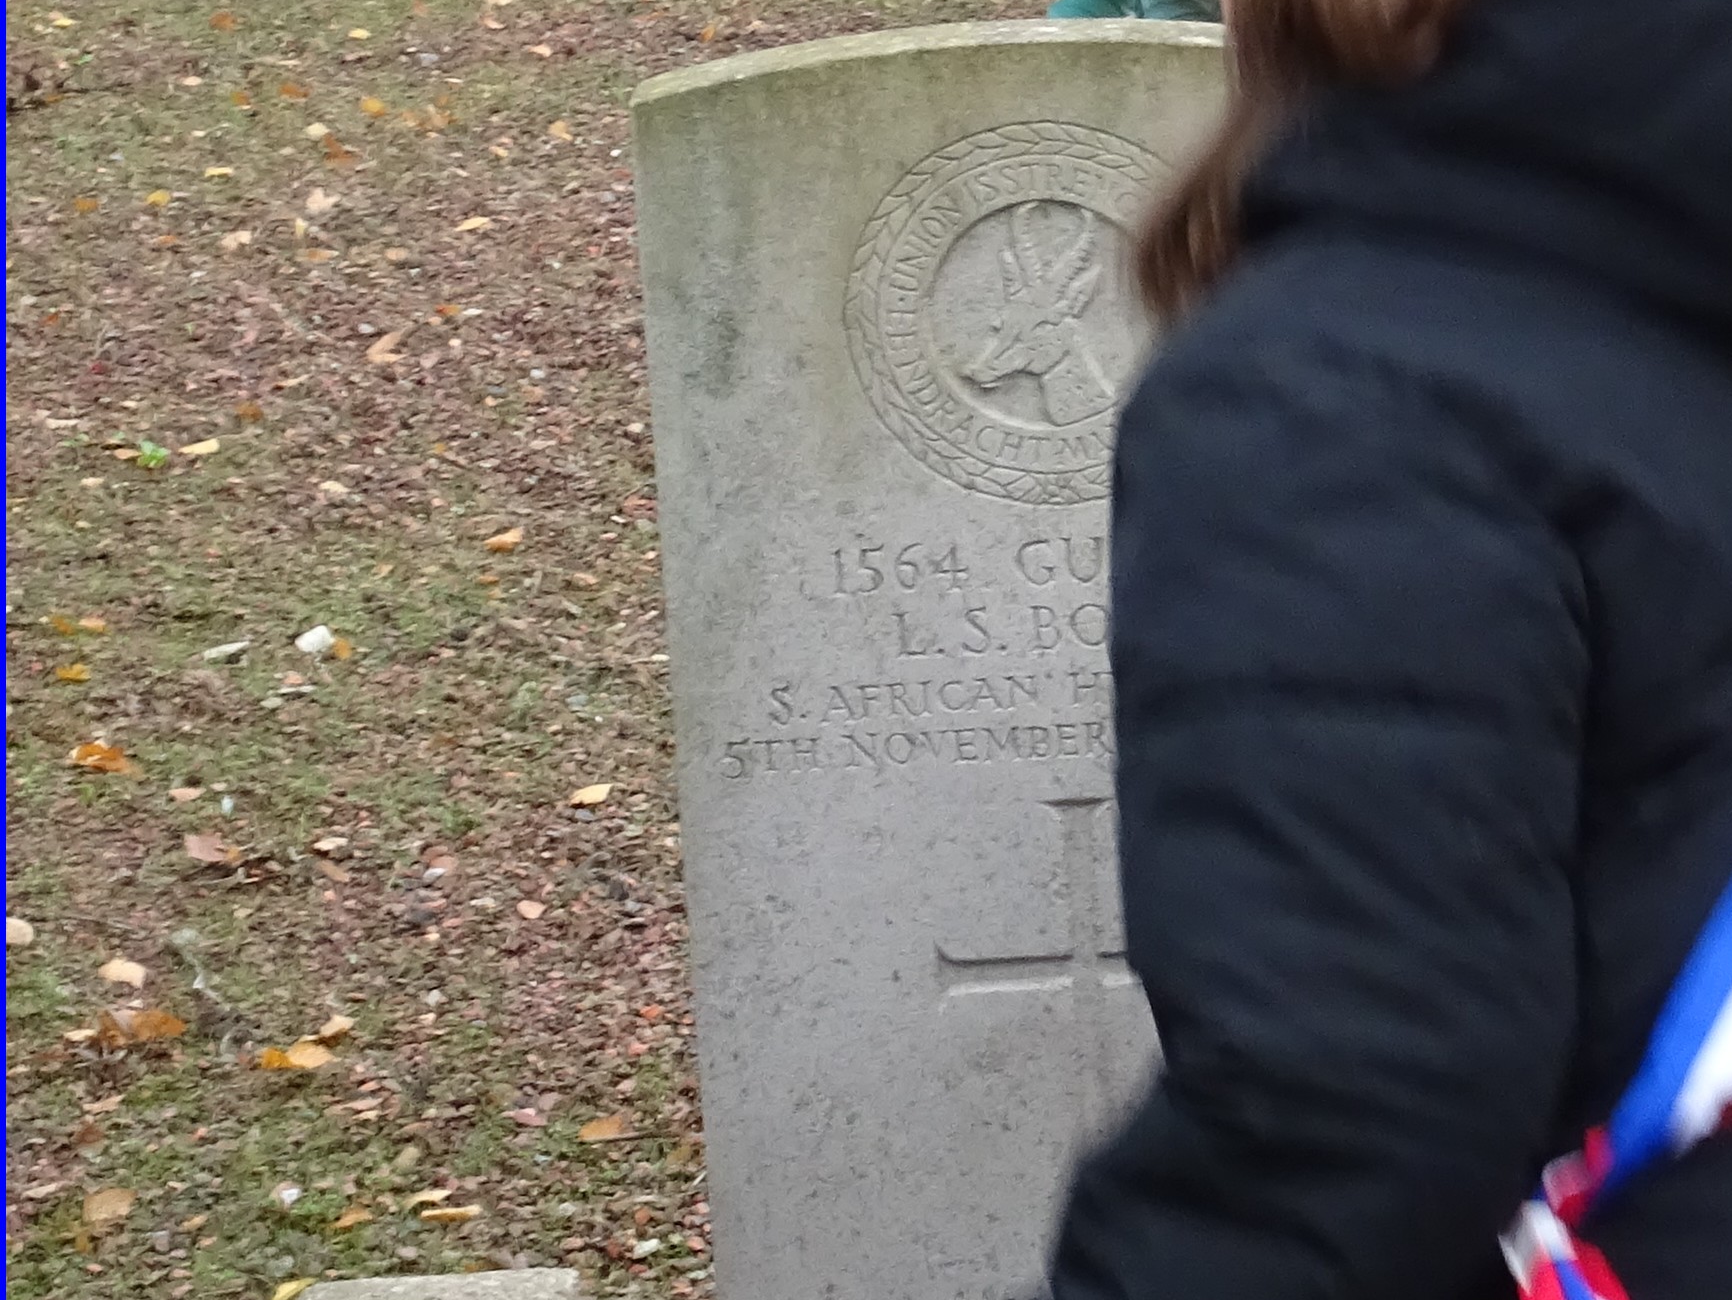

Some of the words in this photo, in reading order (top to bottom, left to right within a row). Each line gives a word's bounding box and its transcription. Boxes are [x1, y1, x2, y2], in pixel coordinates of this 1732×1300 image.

[887, 203, 962, 292] UNION
[830, 542, 969, 595] 1564
[1014, 536, 1104, 585] GU
[1029, 602, 1110, 652] BO
[768, 683, 808, 727] S.
[821, 674, 1038, 725] AFRICAN
[719, 736, 822, 780] 5TH
[842, 720, 1116, 771] NOVEMBER
